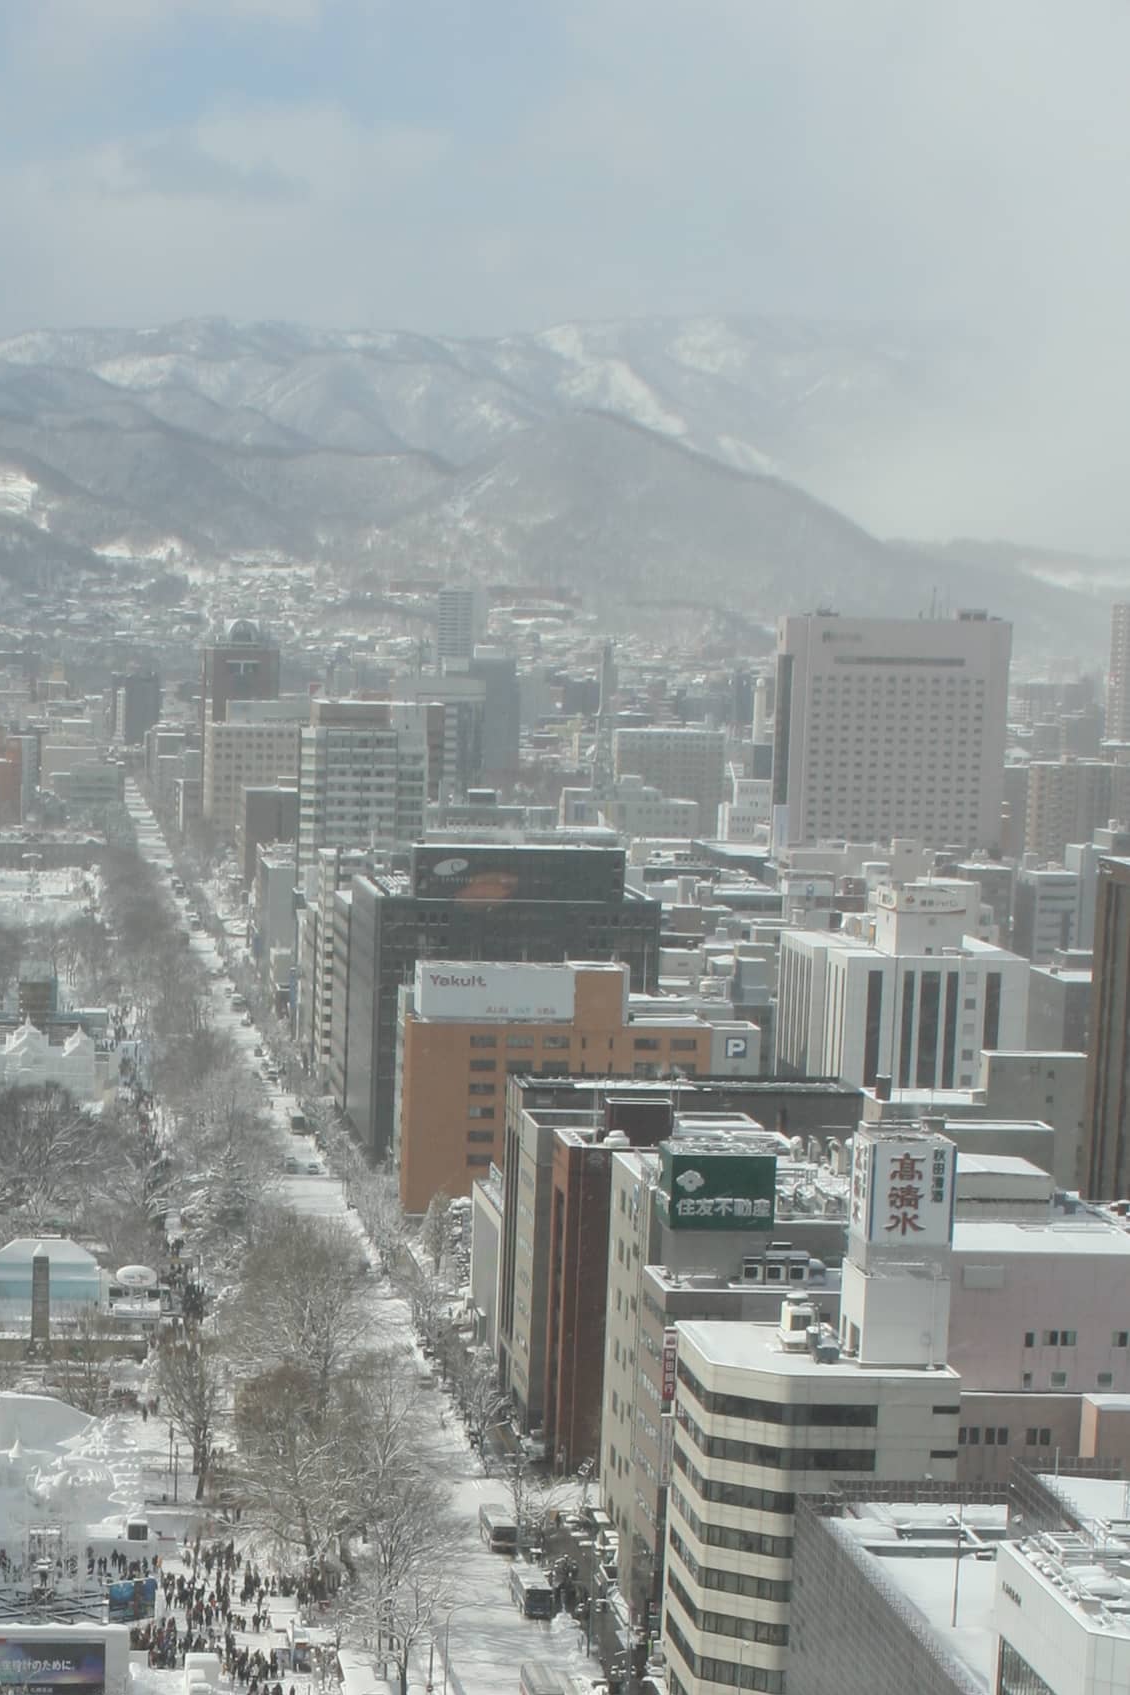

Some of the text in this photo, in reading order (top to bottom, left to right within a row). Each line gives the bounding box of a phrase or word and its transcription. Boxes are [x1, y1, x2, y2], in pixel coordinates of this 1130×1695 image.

[429, 974, 487, 988] Yakult
[726, 1038, 747, 1057] P
[675, 1198, 771, 1217] 住友不動産
